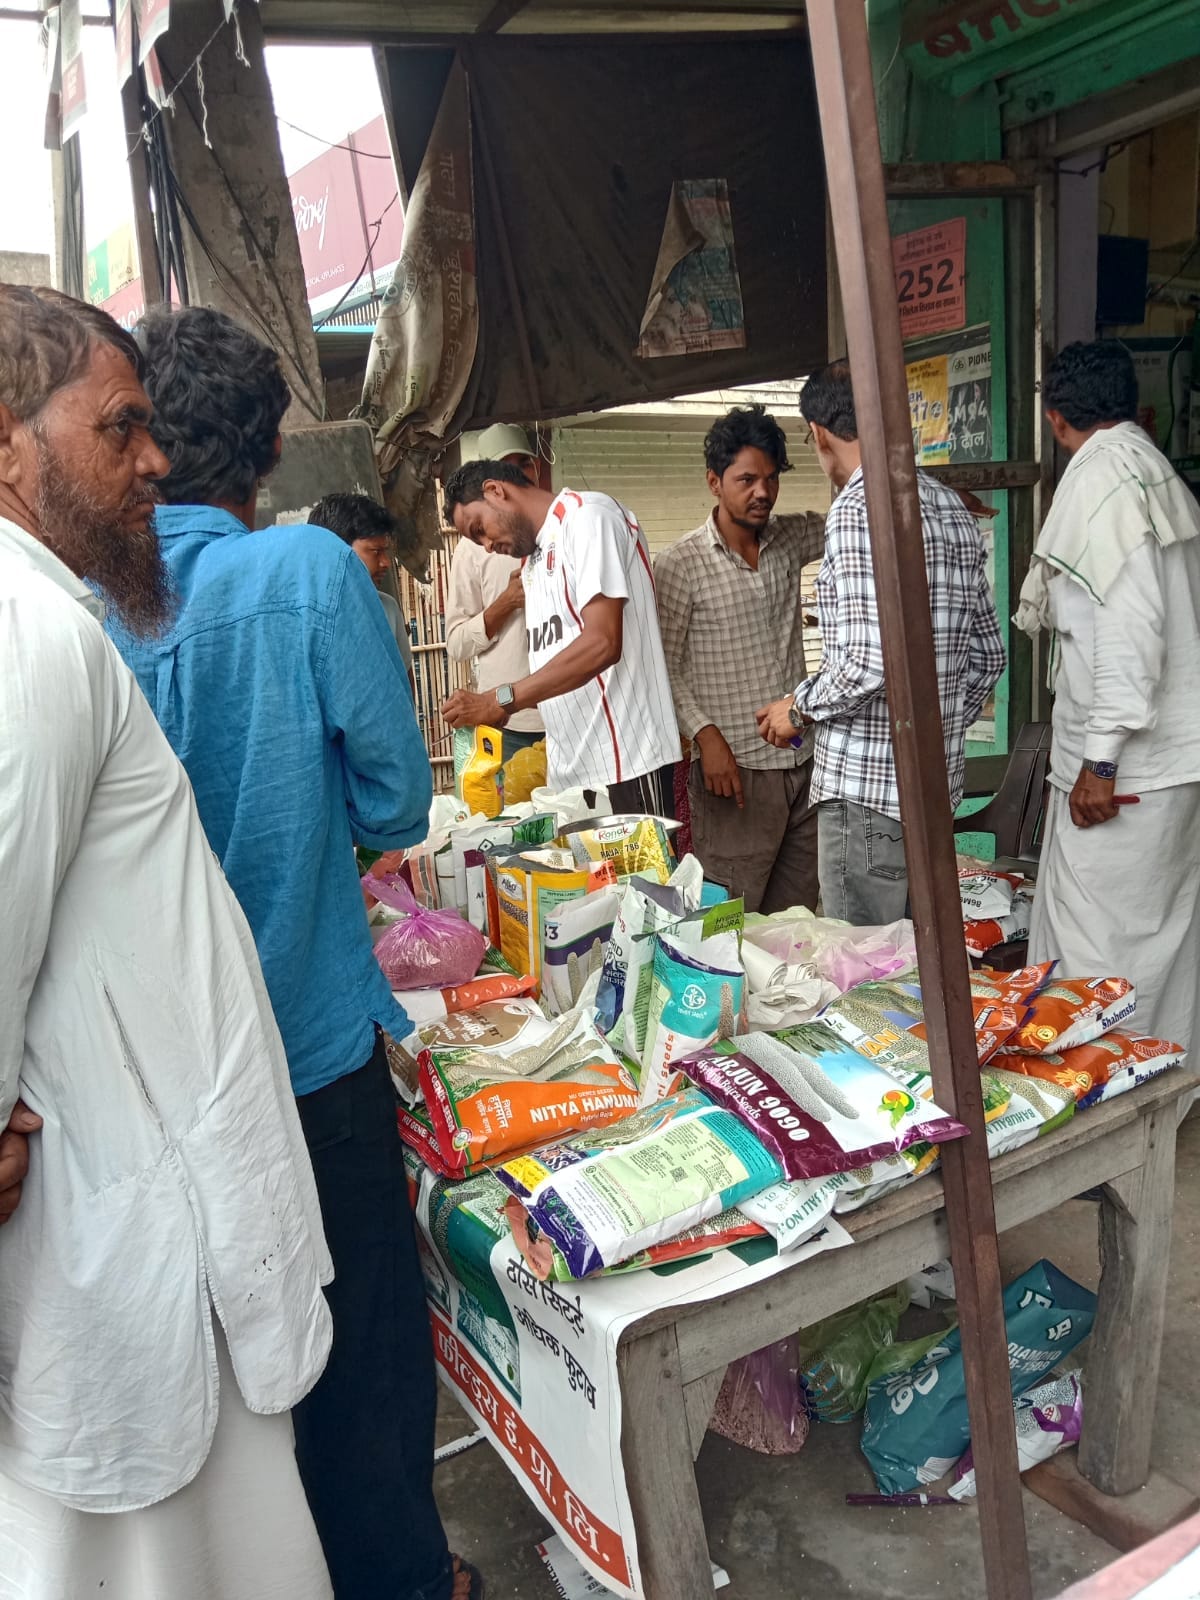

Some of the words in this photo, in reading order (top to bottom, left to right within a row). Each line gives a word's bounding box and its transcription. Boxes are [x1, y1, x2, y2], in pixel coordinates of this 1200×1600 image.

[293, 186, 328, 251] odrej
[598, 825, 630, 840] Ronak
[624, 842, 640, 853] 786
[661, 1033, 674, 1079] seeds
[529, 1100, 580, 1123] NITYA
[708, 1056, 768, 1096] ARJUN
[759, 1096, 810, 1141] 9090
[740, 1095, 761, 1120] Seeds
[514, 1304, 560, 1358] अधिक
